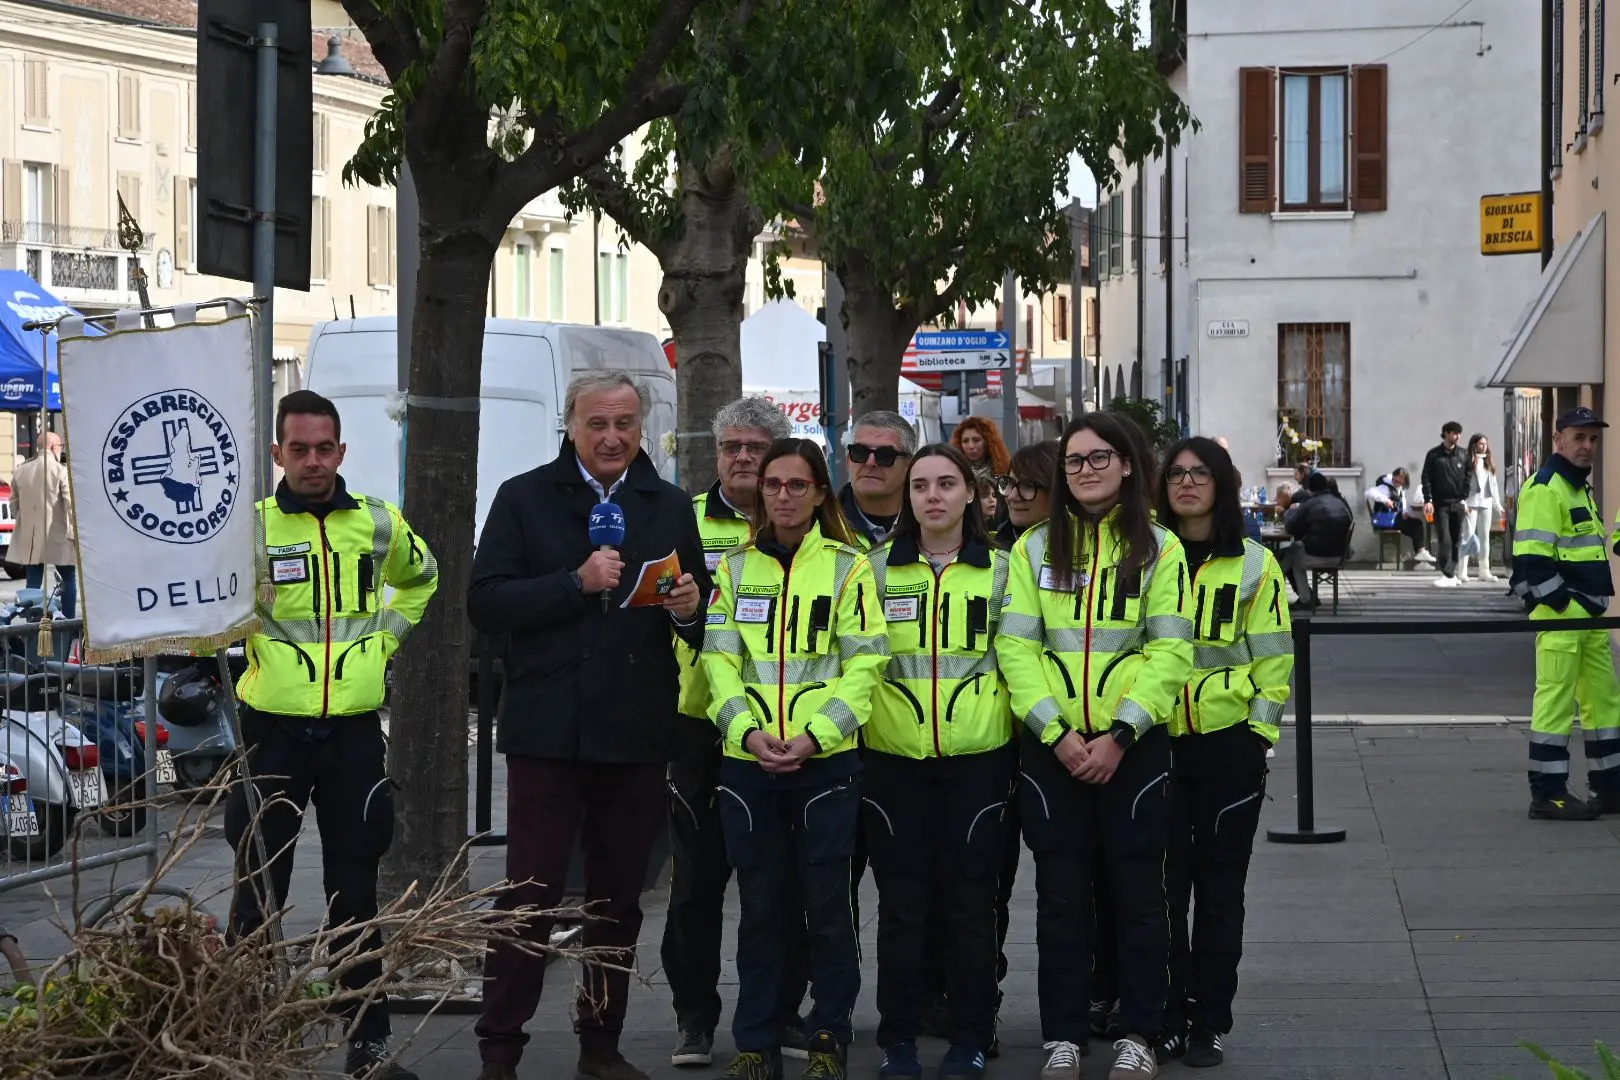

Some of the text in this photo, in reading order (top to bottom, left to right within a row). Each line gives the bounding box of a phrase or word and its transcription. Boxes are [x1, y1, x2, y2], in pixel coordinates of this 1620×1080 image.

[1484, 202, 1532, 216] GIORNALE
[1502, 217, 1514, 229] DI
[1484, 230, 1534, 245] BRESCIA
[918, 336, 987, 346] QUINZANO D'OGLIO
[919, 357, 966, 366] biblioteca
[0, 383, 34, 393] UPERTI
[126, 488, 232, 539] SOCCORSO
[137, 572, 238, 612] DELLO
